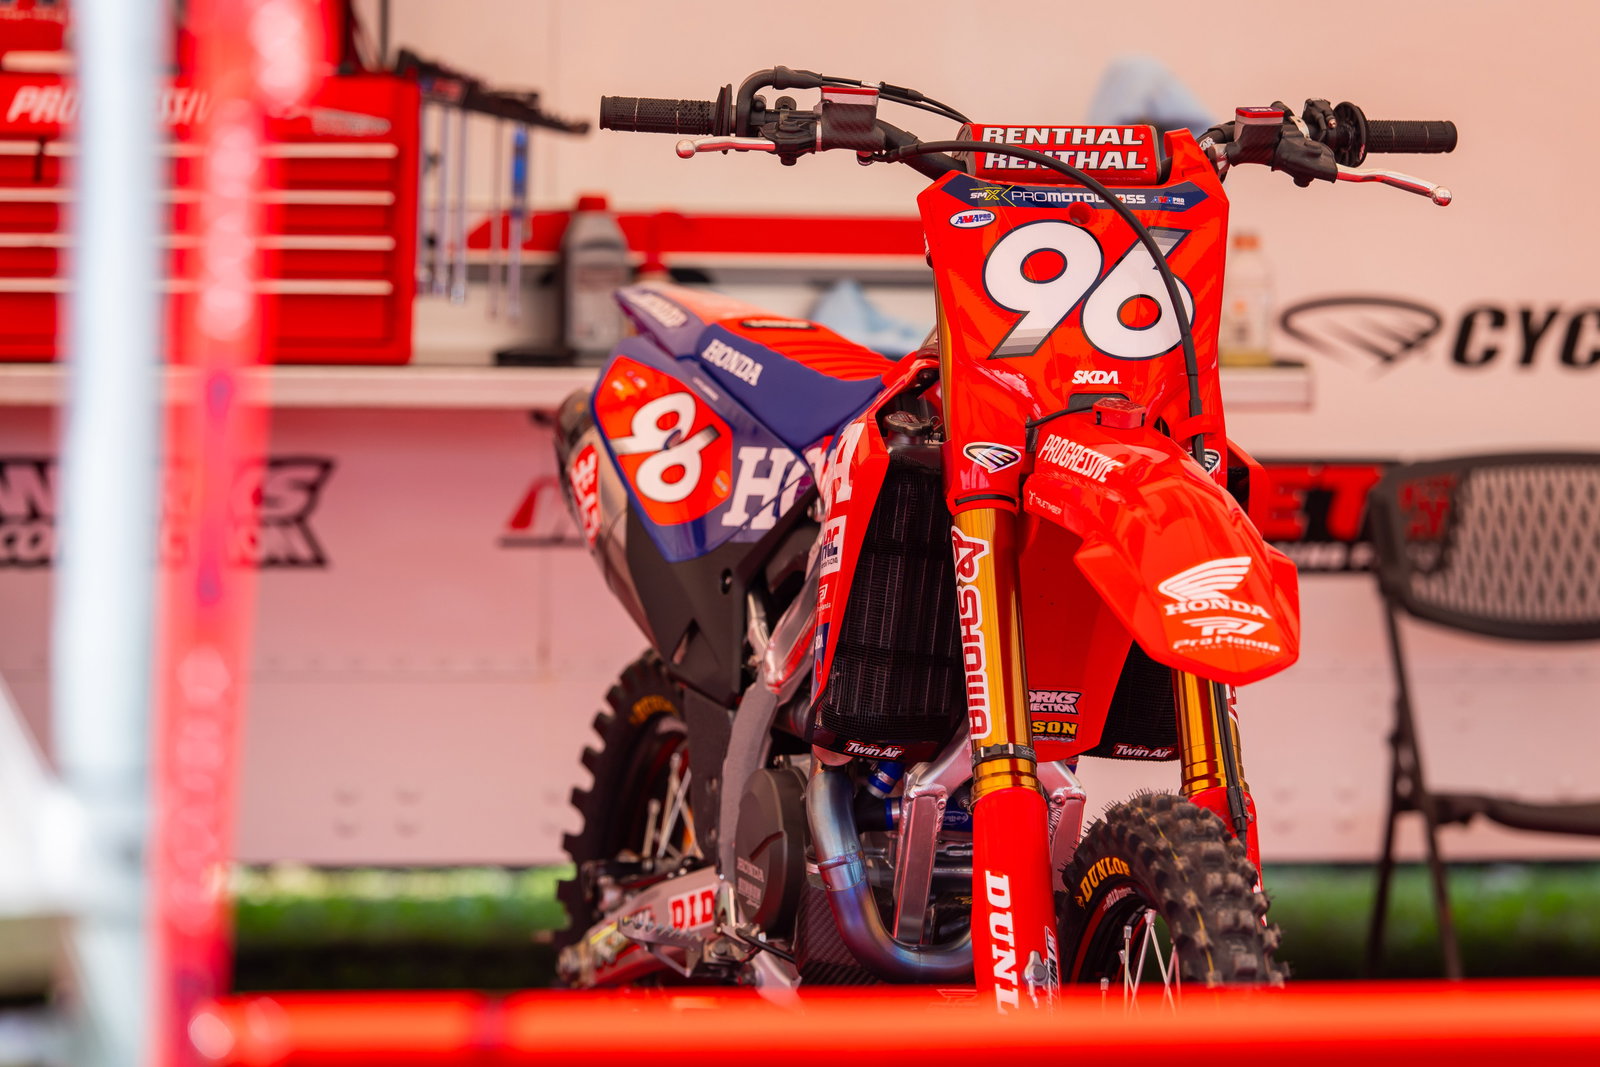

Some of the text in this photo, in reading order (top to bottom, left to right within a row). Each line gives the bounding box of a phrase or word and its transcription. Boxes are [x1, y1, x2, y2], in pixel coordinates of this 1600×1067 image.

[982, 127, 1144, 145] RENTHAL
[970, 189, 1001, 200] SMX
[983, 219, 1195, 361] 96
[701, 339, 765, 387] HONDA
[1071, 370, 1119, 385] SKDA
[609, 391, 722, 503] 96
[1038, 433, 1125, 483] PROGRESSIVE
[1163, 598, 1272, 619] HONDA
[957, 584, 992, 740] SHOWA
[847, 742, 903, 758] Twin Air
[1116, 744, 1172, 758] Twin Air
[1080, 857, 1131, 903] DUNLOP
[985, 870, 1020, 1016] DUNL
